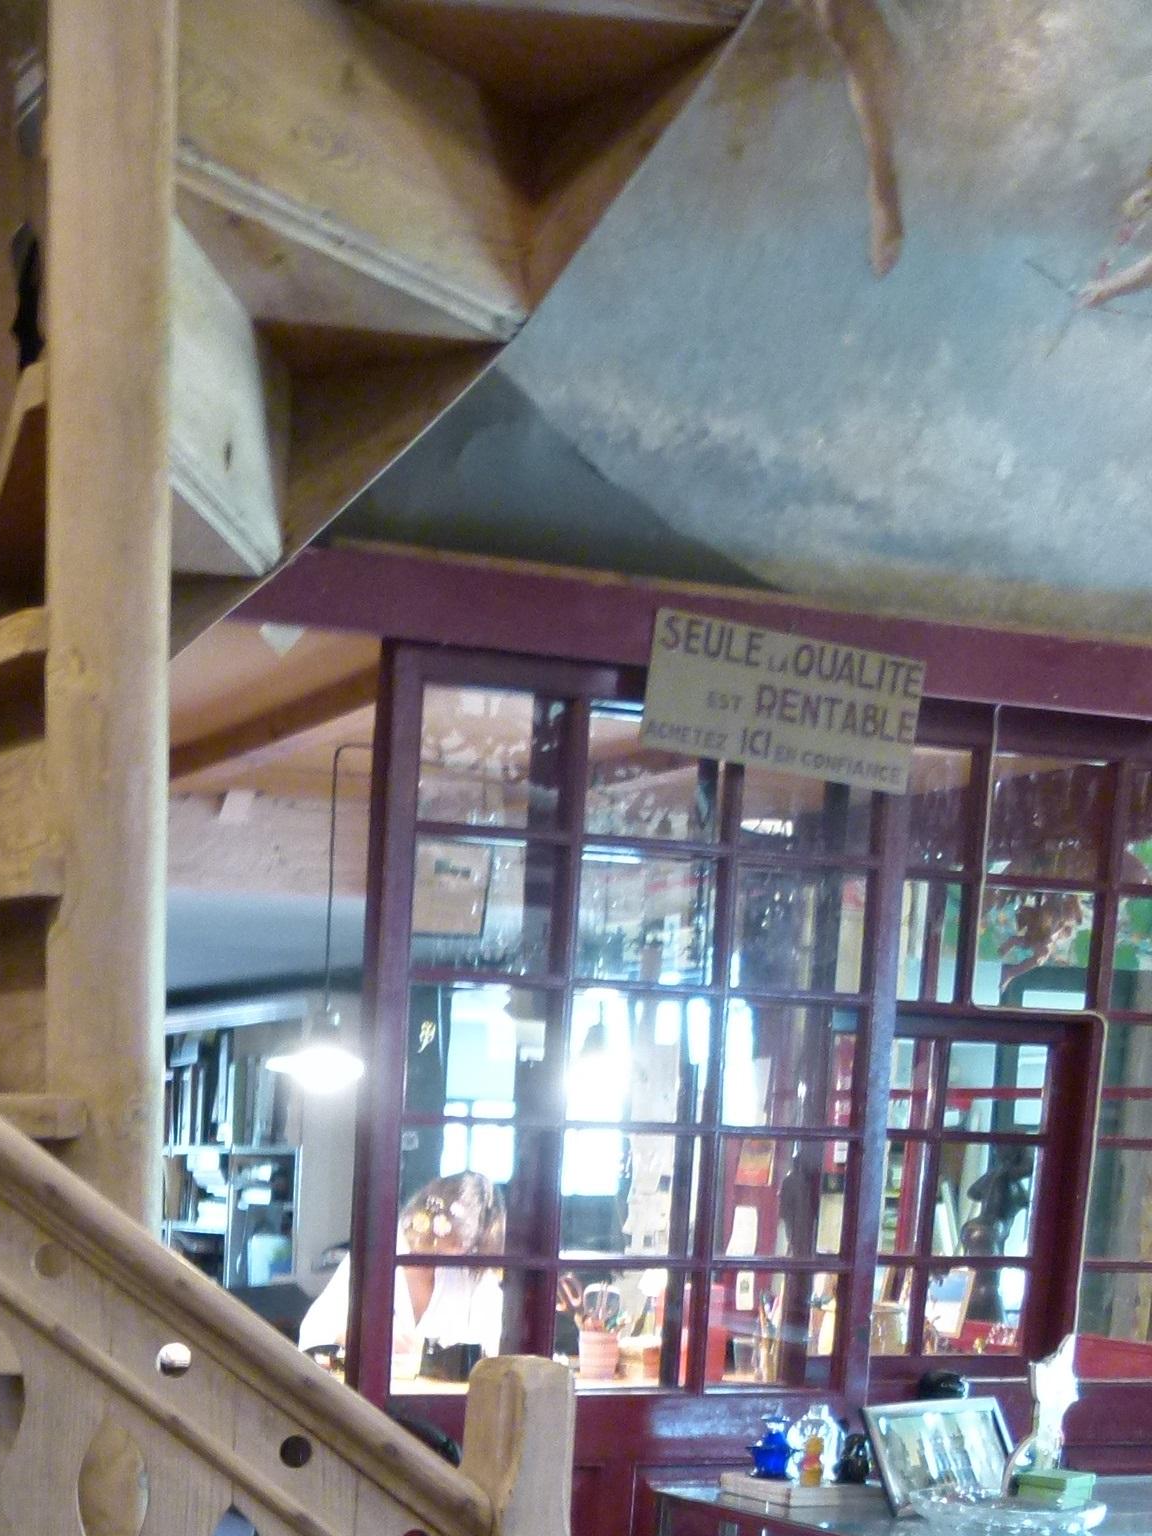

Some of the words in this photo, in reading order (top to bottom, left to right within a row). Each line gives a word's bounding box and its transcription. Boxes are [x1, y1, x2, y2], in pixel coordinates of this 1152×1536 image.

[659, 614, 765, 668] SEULE
[707, 690, 743, 714] EST
[755, 683, 917, 745] RENTABLE
[740, 726, 772, 760] ICI
